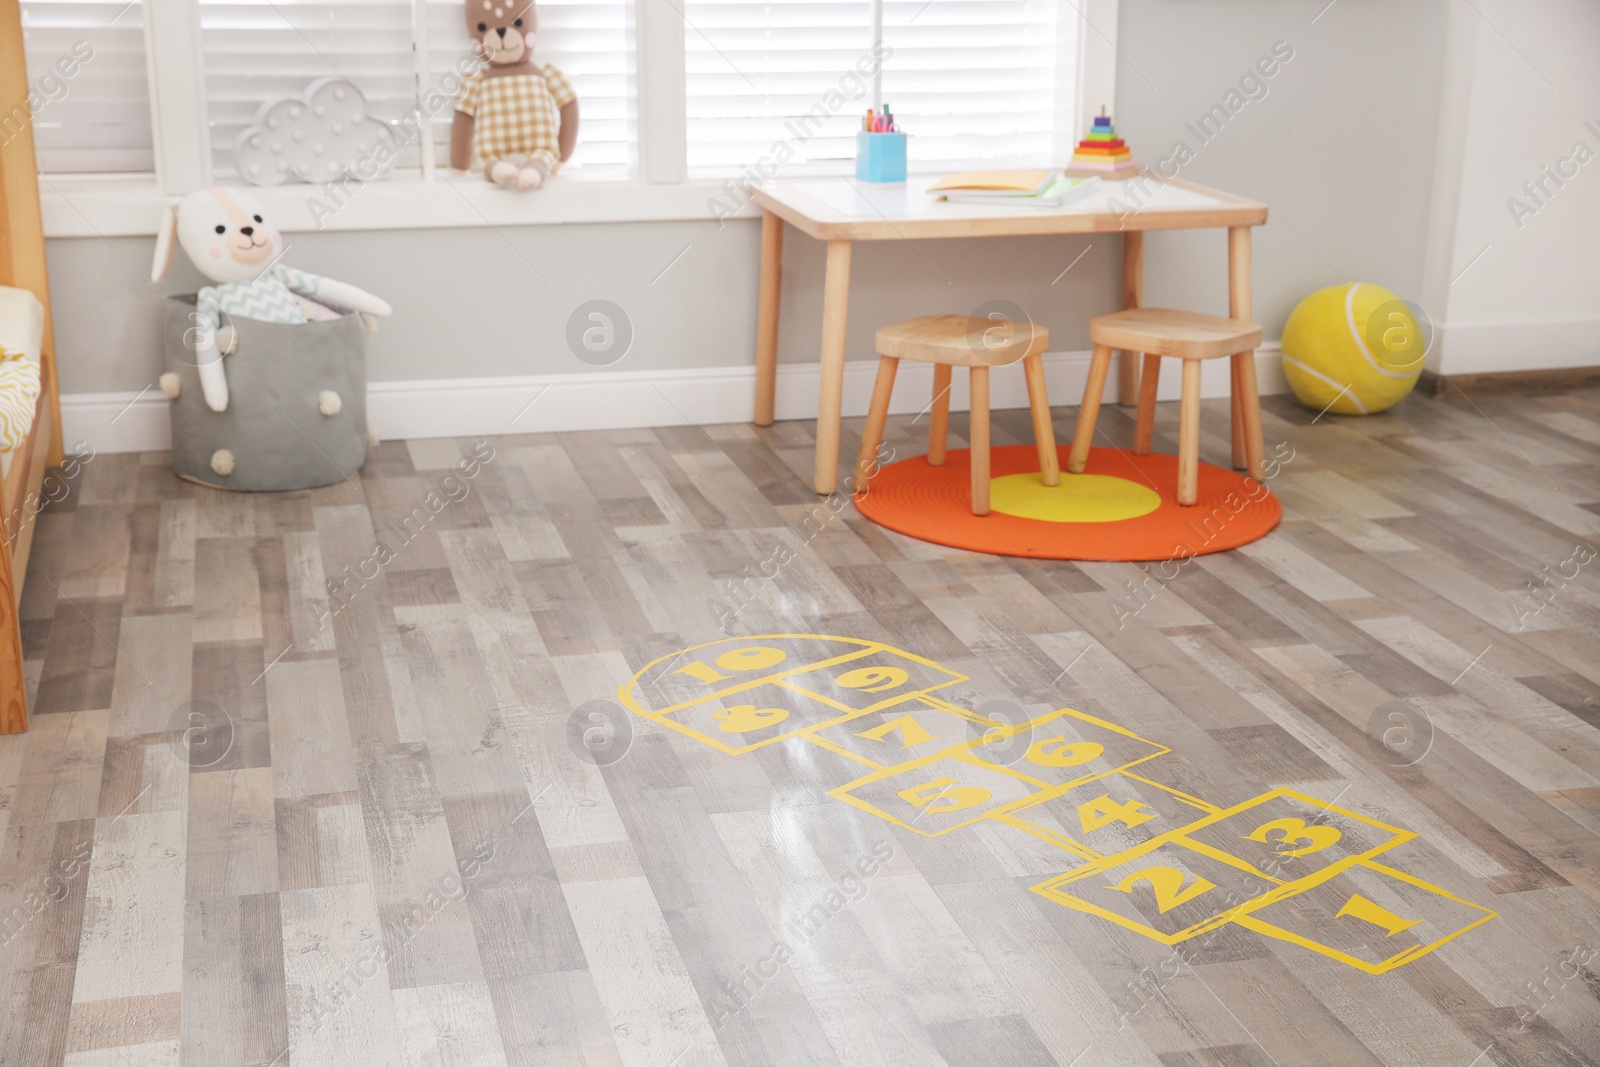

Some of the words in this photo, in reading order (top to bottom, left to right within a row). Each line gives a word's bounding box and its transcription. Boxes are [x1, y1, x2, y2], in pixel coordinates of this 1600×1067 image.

[670, 647, 787, 685] 10
[835, 667, 909, 693] 9
[711, 705, 790, 733] 8
[852, 715, 941, 749] 7
[1026, 733, 1104, 768] 6
[896, 776, 992, 816] 5
[1077, 794, 1160, 834] 4
[1240, 817, 1342, 859] 3
[1102, 866, 1217, 915] 2
[1334, 893, 1425, 938] 1
